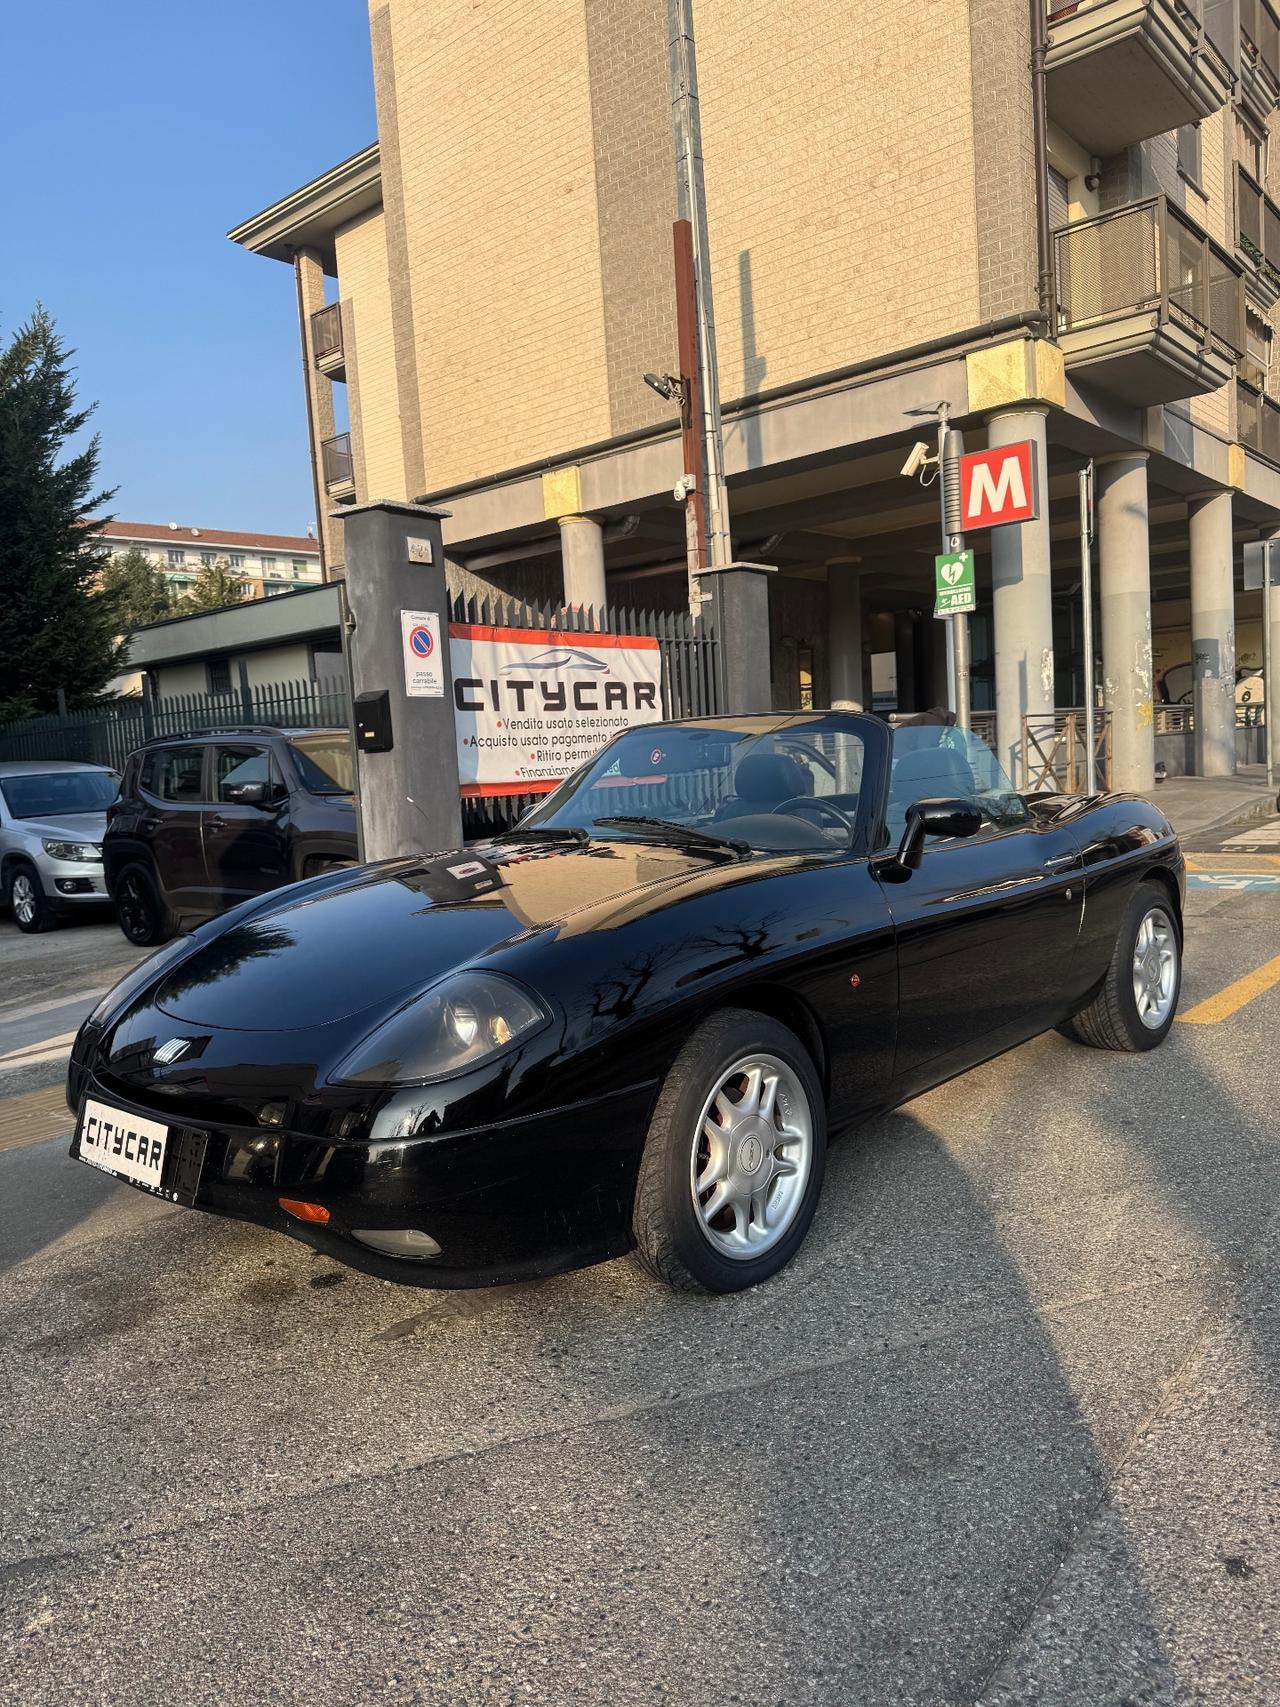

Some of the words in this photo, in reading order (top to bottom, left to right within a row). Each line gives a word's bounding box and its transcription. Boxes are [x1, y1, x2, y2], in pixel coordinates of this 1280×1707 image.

[967, 455, 1028, 518] M
[950, 592, 972, 607] AED
[412, 677, 438, 685] carrabile
[453, 678, 657, 712] CITYCAR
[502, 717, 543, 730] Vendita
[546, 718, 573, 729] usato
[575, 715, 629, 728] selezionato
[469, 735, 518, 749] Acquisto
[521, 734, 549, 746] usato
[551, 732, 607, 749] pagamento
[536, 749, 562, 761] Ritiro
[86, 1117, 163, 1171] CITYCAR
